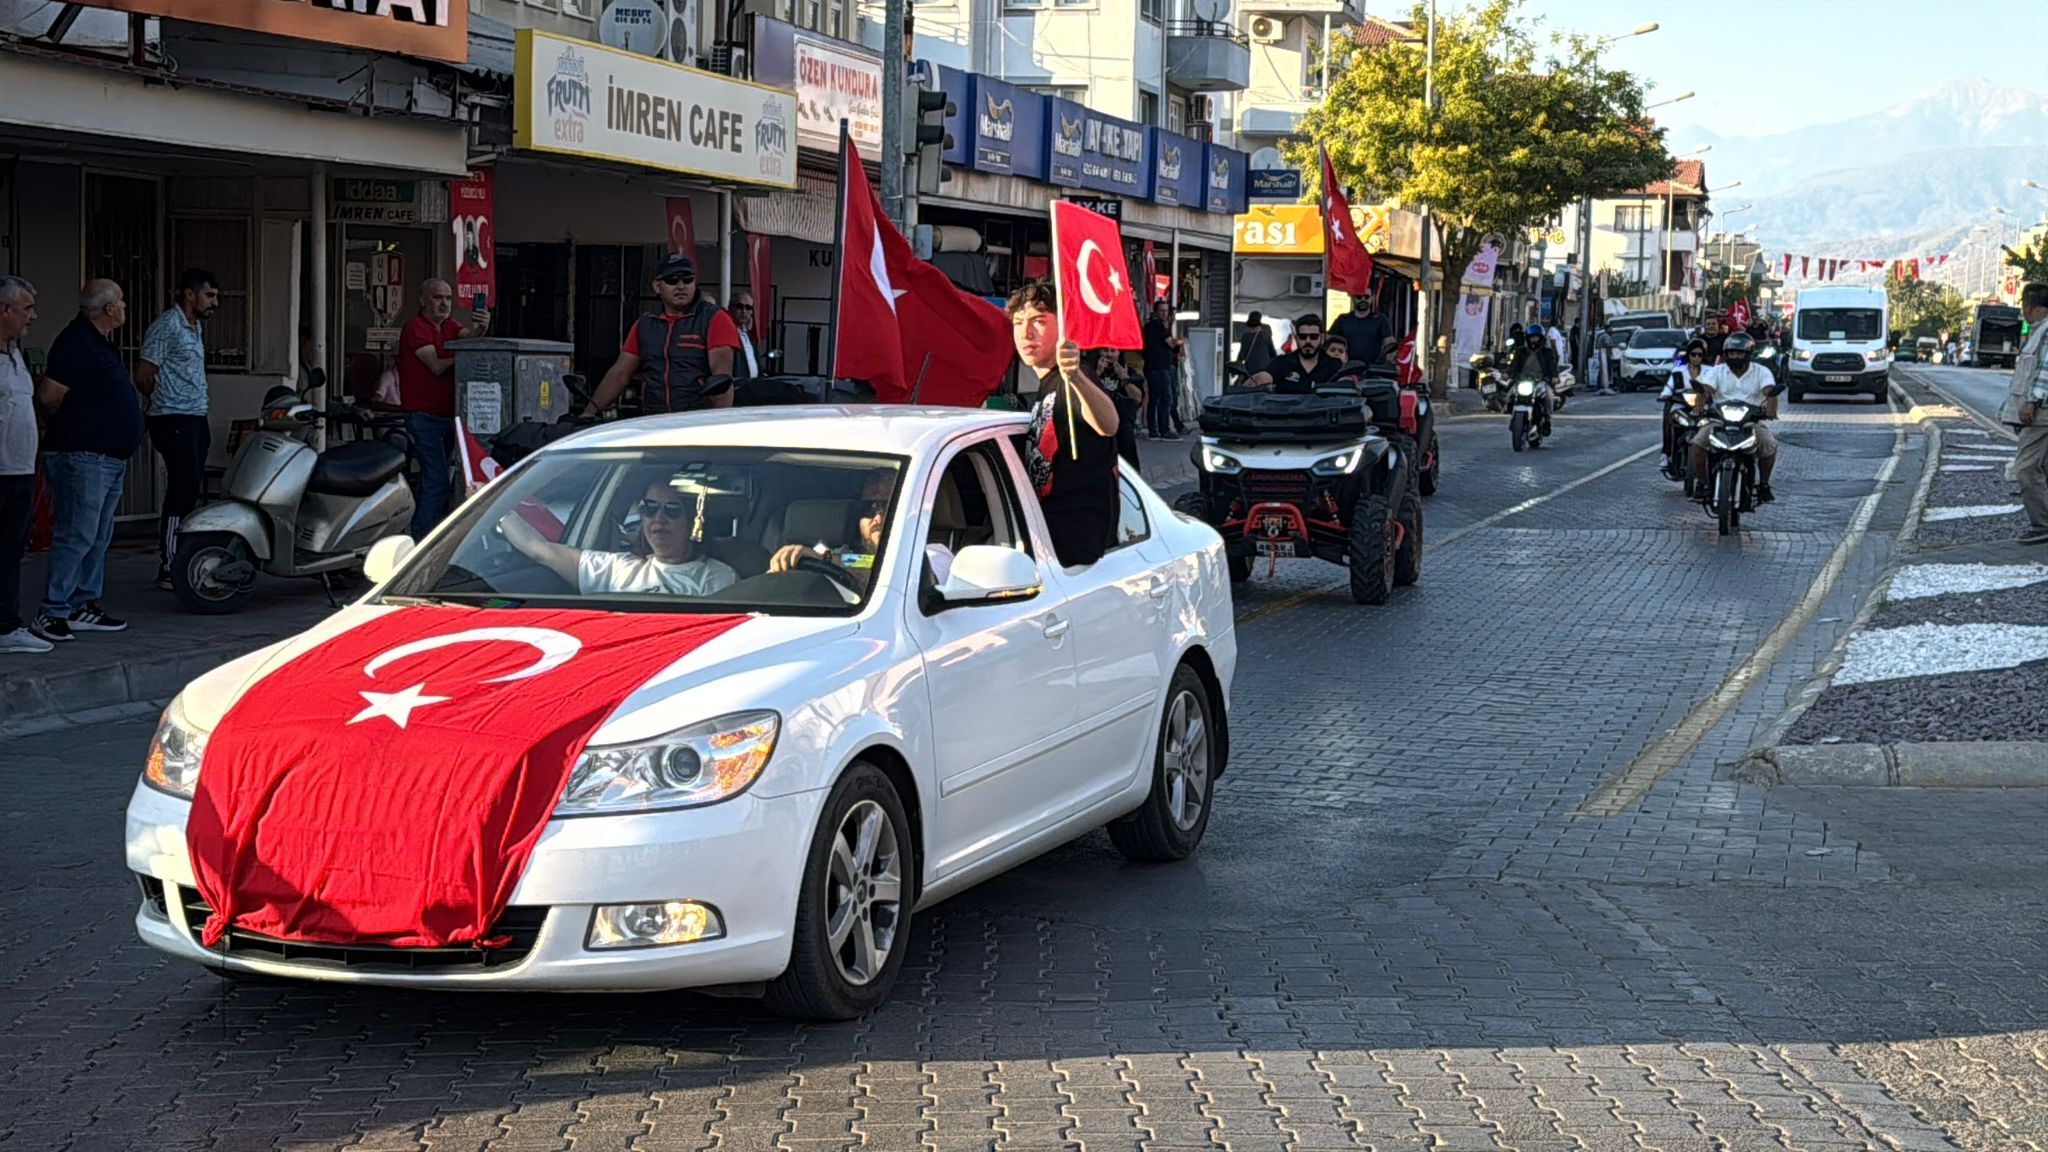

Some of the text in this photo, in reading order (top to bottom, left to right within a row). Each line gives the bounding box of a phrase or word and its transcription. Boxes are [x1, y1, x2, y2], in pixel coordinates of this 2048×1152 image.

[615, 8, 652, 18] MESUT
[799, 49, 878, 101] ÖZEN KUNDURA
[607, 74, 743, 154] İMREN CAFE
[554, 115, 584, 143] extra
[1253, 179, 1295, 189] Marshall
[387, 210, 415, 220] CAFE
